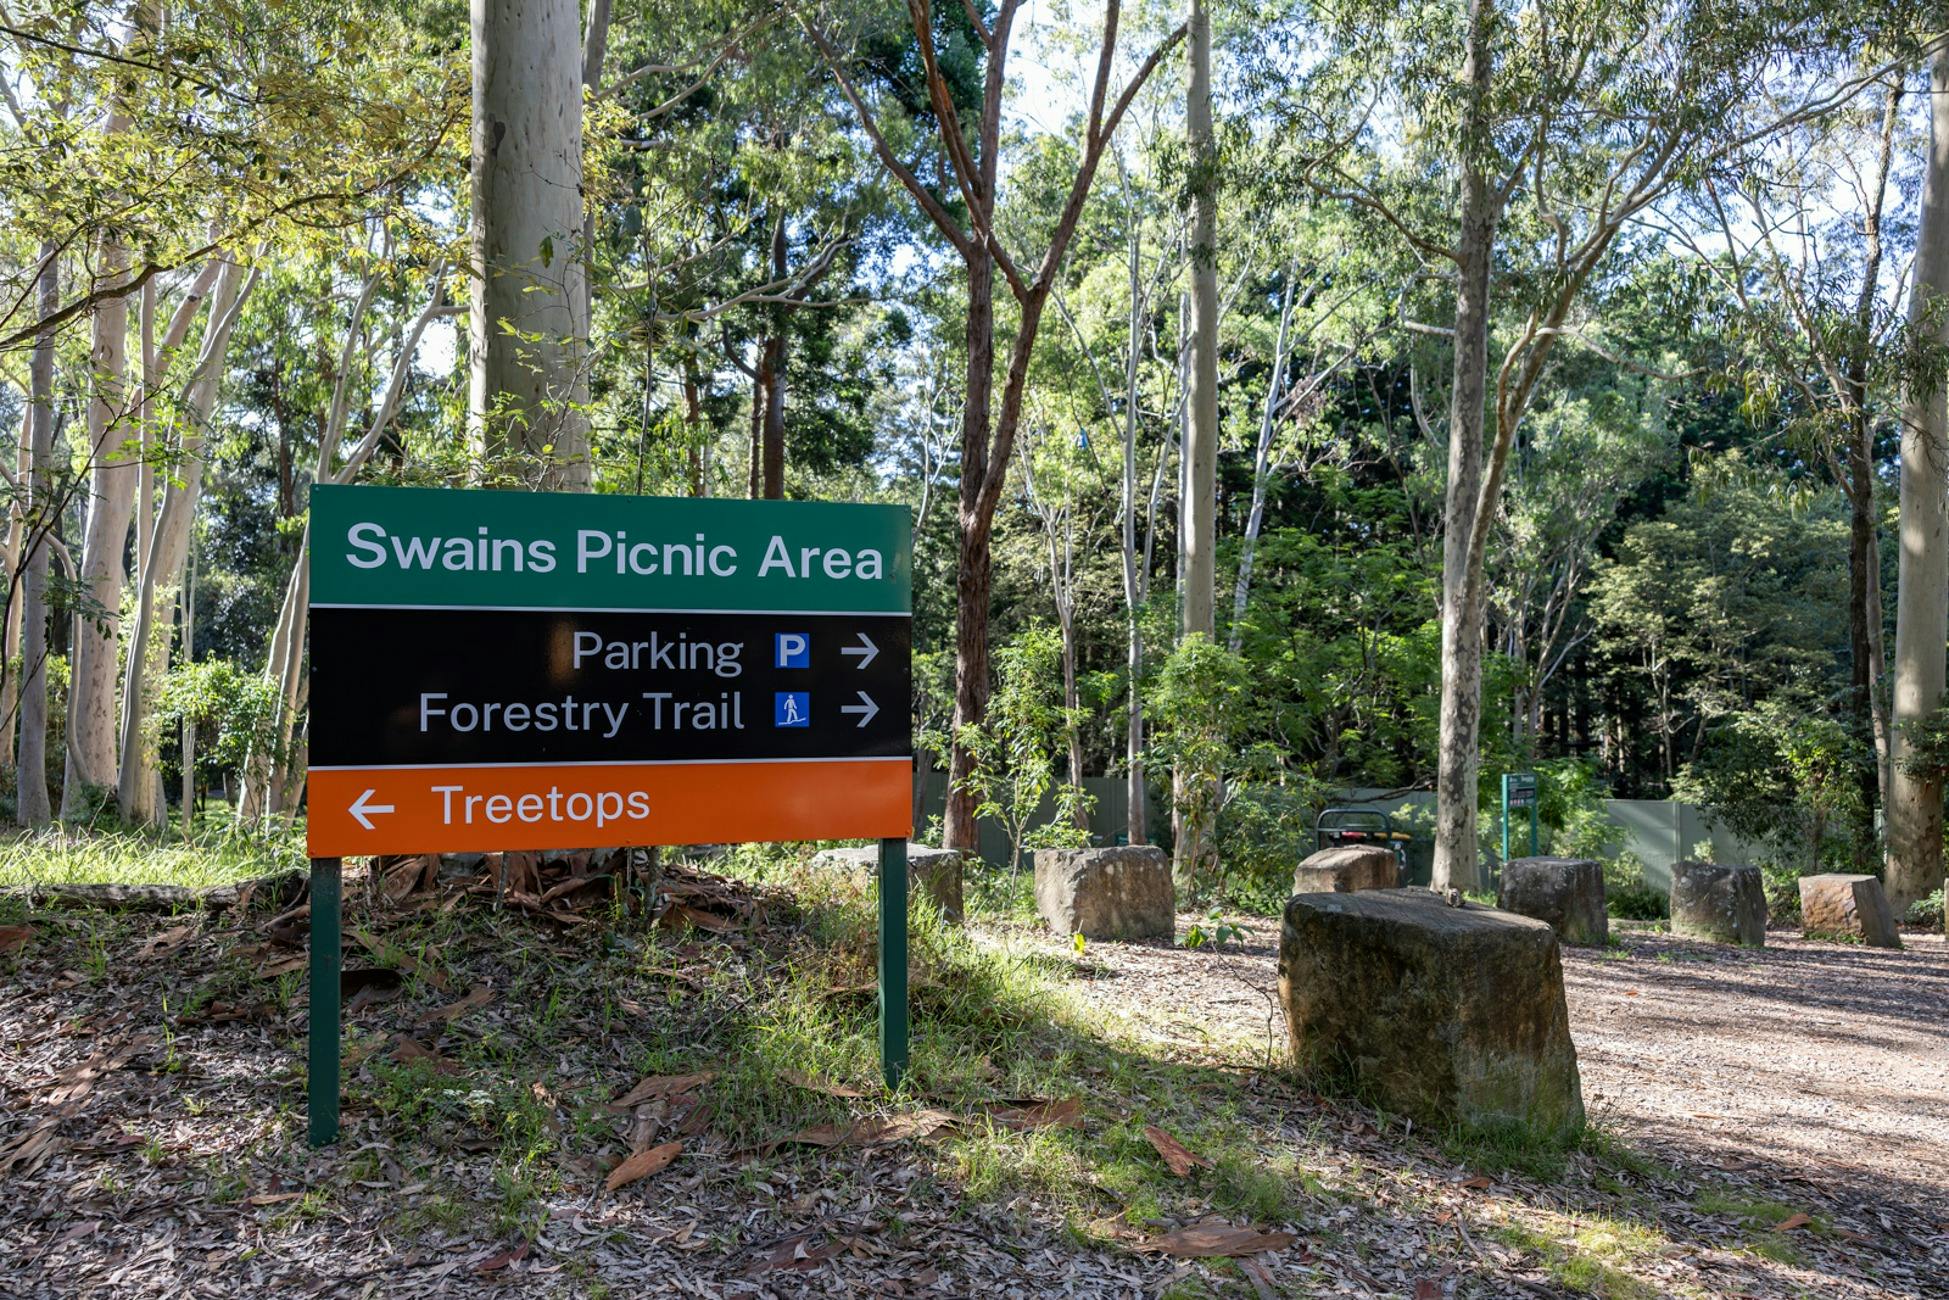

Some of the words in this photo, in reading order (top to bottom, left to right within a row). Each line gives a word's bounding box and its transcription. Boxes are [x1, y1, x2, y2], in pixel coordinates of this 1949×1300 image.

[346, 522, 557, 572] Swains
[577, 529, 738, 577] Picnic
[757, 535, 884, 580] Area
[572, 631, 744, 677] Parking
[779, 635, 807, 667] P
[420, 692, 629, 738] Forestry
[642, 691, 745, 730] Trail
[431, 785, 650, 828] Treetops
